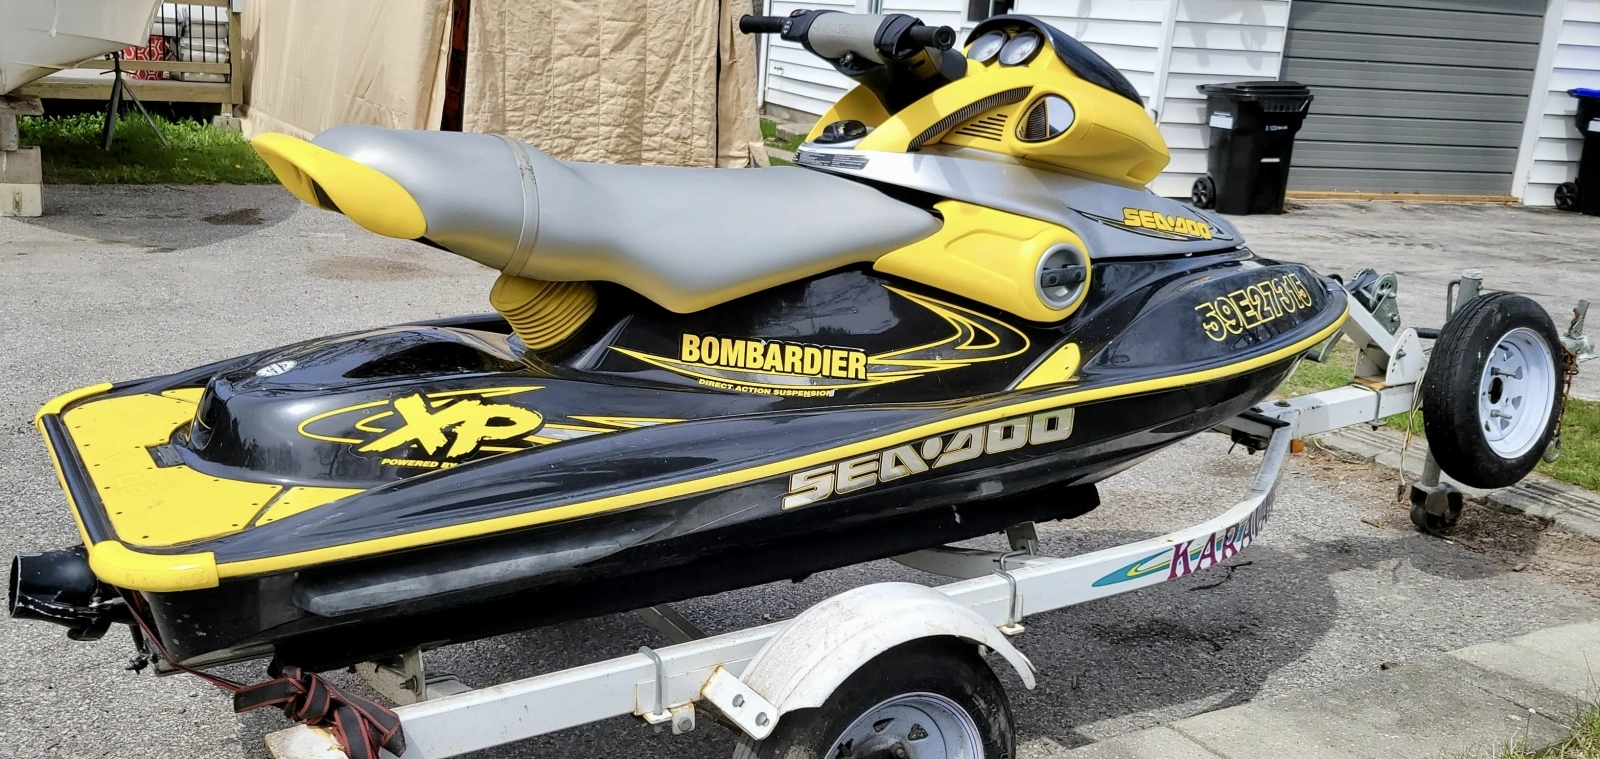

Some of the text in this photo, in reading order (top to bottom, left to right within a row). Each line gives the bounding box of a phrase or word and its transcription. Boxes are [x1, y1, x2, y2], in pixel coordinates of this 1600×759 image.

[681, 334, 867, 379] BOMBARDIER
[698, 379, 734, 390] DIRECT
[734, 385, 771, 395] ACTION
[358, 391, 544, 459] XP
[381, 458, 439, 468] POWERED
